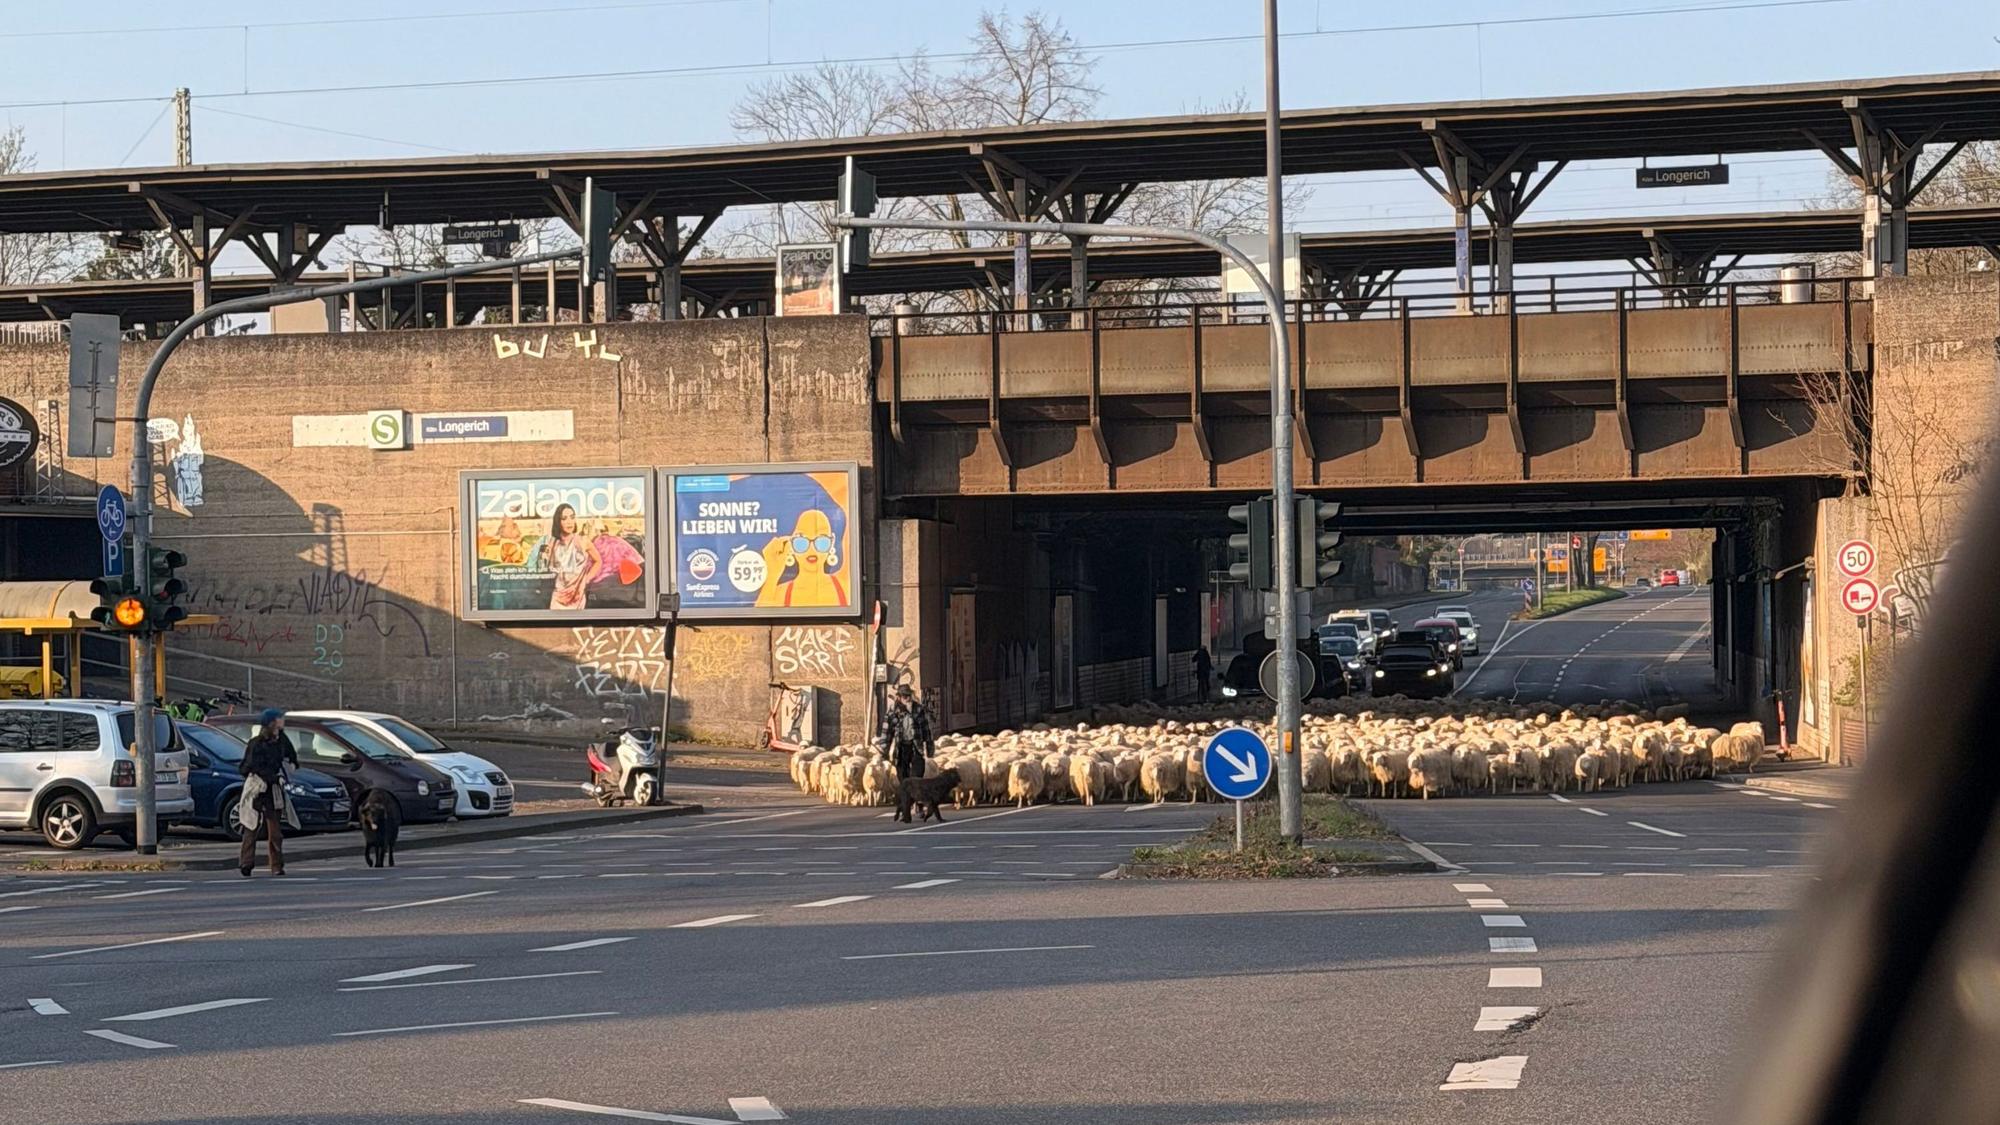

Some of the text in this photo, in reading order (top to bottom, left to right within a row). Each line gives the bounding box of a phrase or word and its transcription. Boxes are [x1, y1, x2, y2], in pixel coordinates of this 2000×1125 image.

[1656, 169, 1710, 183] Longerich
[458, 229, 504, 241] Longerich
[783, 249, 832, 261] zalando
[372, 414, 399, 444] S
[439, 420, 490, 434] Longerich
[480, 481, 643, 519] zalando
[699, 502, 760, 517] SONNE?
[682, 519, 778, 535] LIEBEN WIR!
[108, 542, 119, 572] P
[1847, 550, 1867, 567] 50
